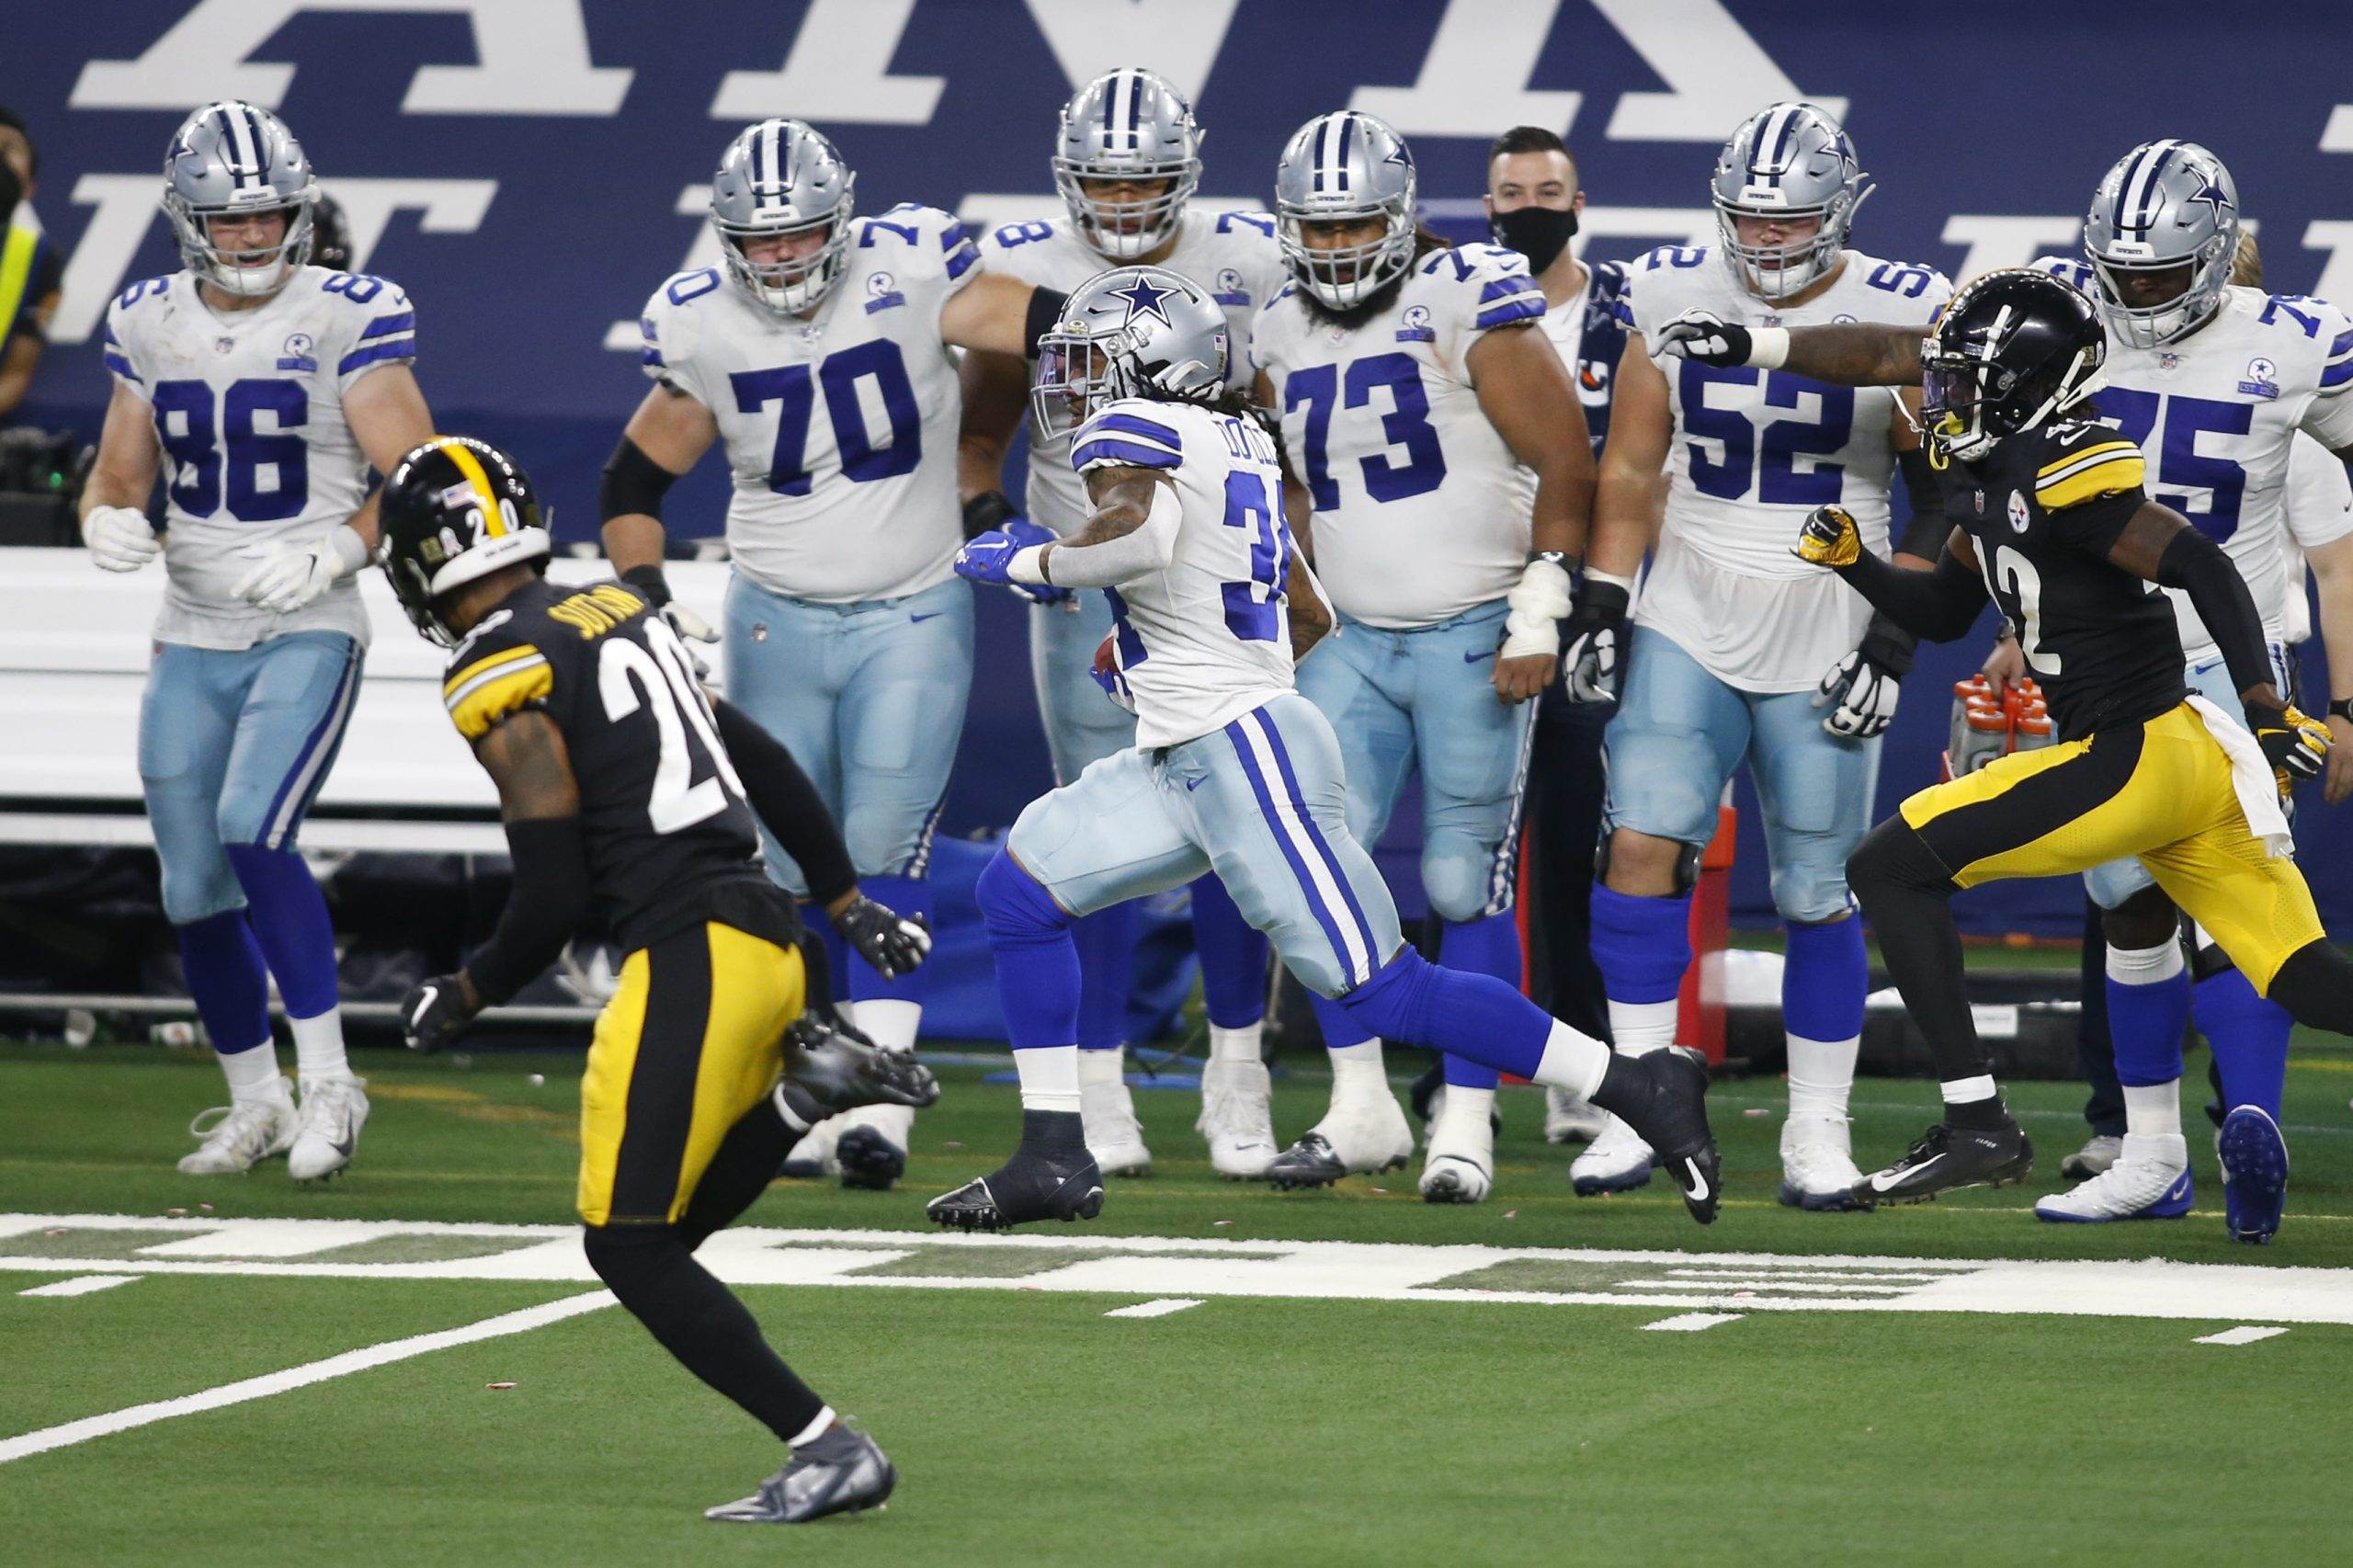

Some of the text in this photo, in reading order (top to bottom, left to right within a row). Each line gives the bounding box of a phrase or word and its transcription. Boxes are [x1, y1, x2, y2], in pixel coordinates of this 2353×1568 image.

[152, 378, 309, 522] 86
[729, 337, 923, 497] 70
[1285, 352, 1449, 512] 73
[1679, 358, 1855, 506] 52
[1971, 534, 2063, 676] 2
[598, 616, 747, 835] 20
